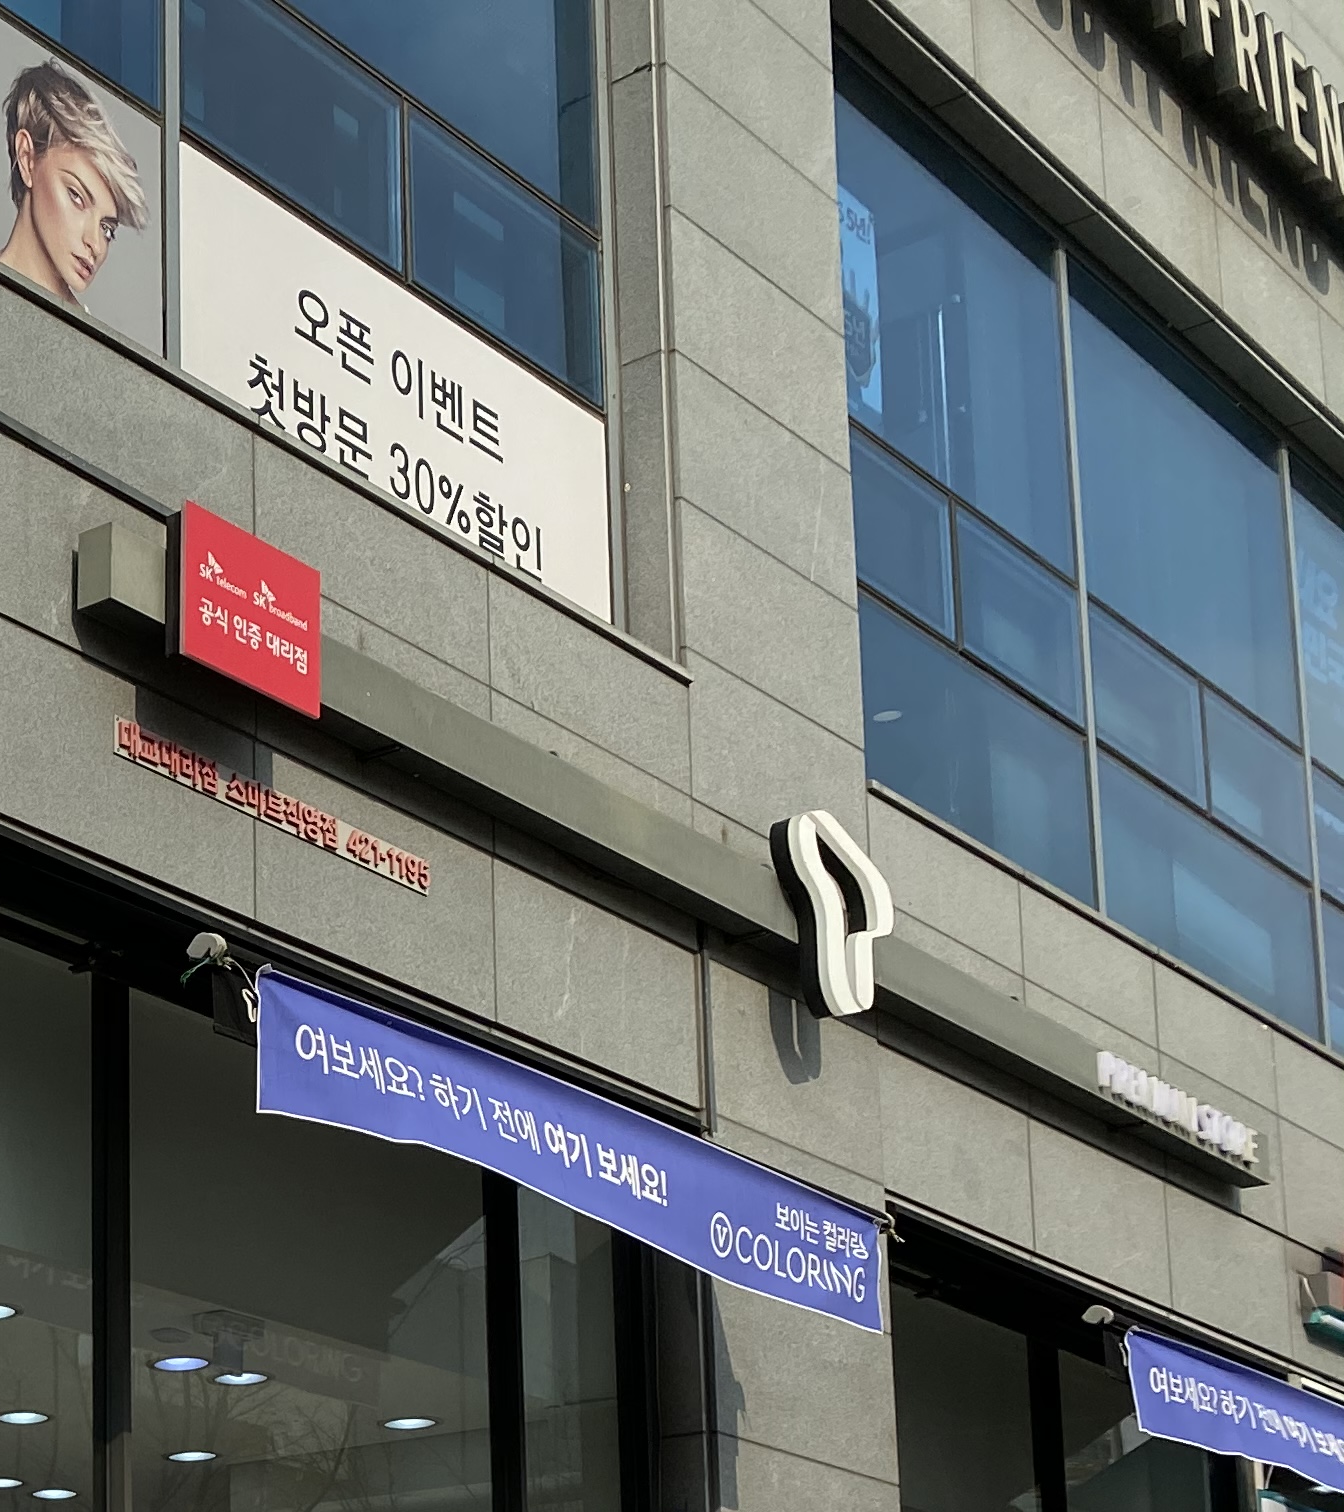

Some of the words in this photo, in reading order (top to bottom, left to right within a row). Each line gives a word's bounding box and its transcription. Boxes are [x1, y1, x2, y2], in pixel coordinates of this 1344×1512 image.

[294, 288, 375, 384] 오픈
[391, 350, 503, 463] 이벤트
[247, 352, 373, 482] 첫방문
[199, 597, 228, 634] 공식
[233, 614, 262, 649] 인증
[266, 632, 308, 675] 대리점
[216, 575, 248, 600] telecom
[269, 605, 308, 632] broadband
[225, 774, 339, 851] 스마트직영점
[346, 829, 431, 890] 421-1195
[295, 1023, 426, 1101] 여보세요?
[429, 1074, 485, 1129] 하기
[489, 1097, 540, 1154] 전에
[545, 1123, 592, 1178] 여기
[598, 1147, 668, 1208] 보세요!
[735, 1227, 866, 1303] COLORING
[775, 1202, 819, 1245] 보이는
[822, 1220, 869, 1261] 컬러링
[1149, 1365, 1217, 1414] 여보세요?
